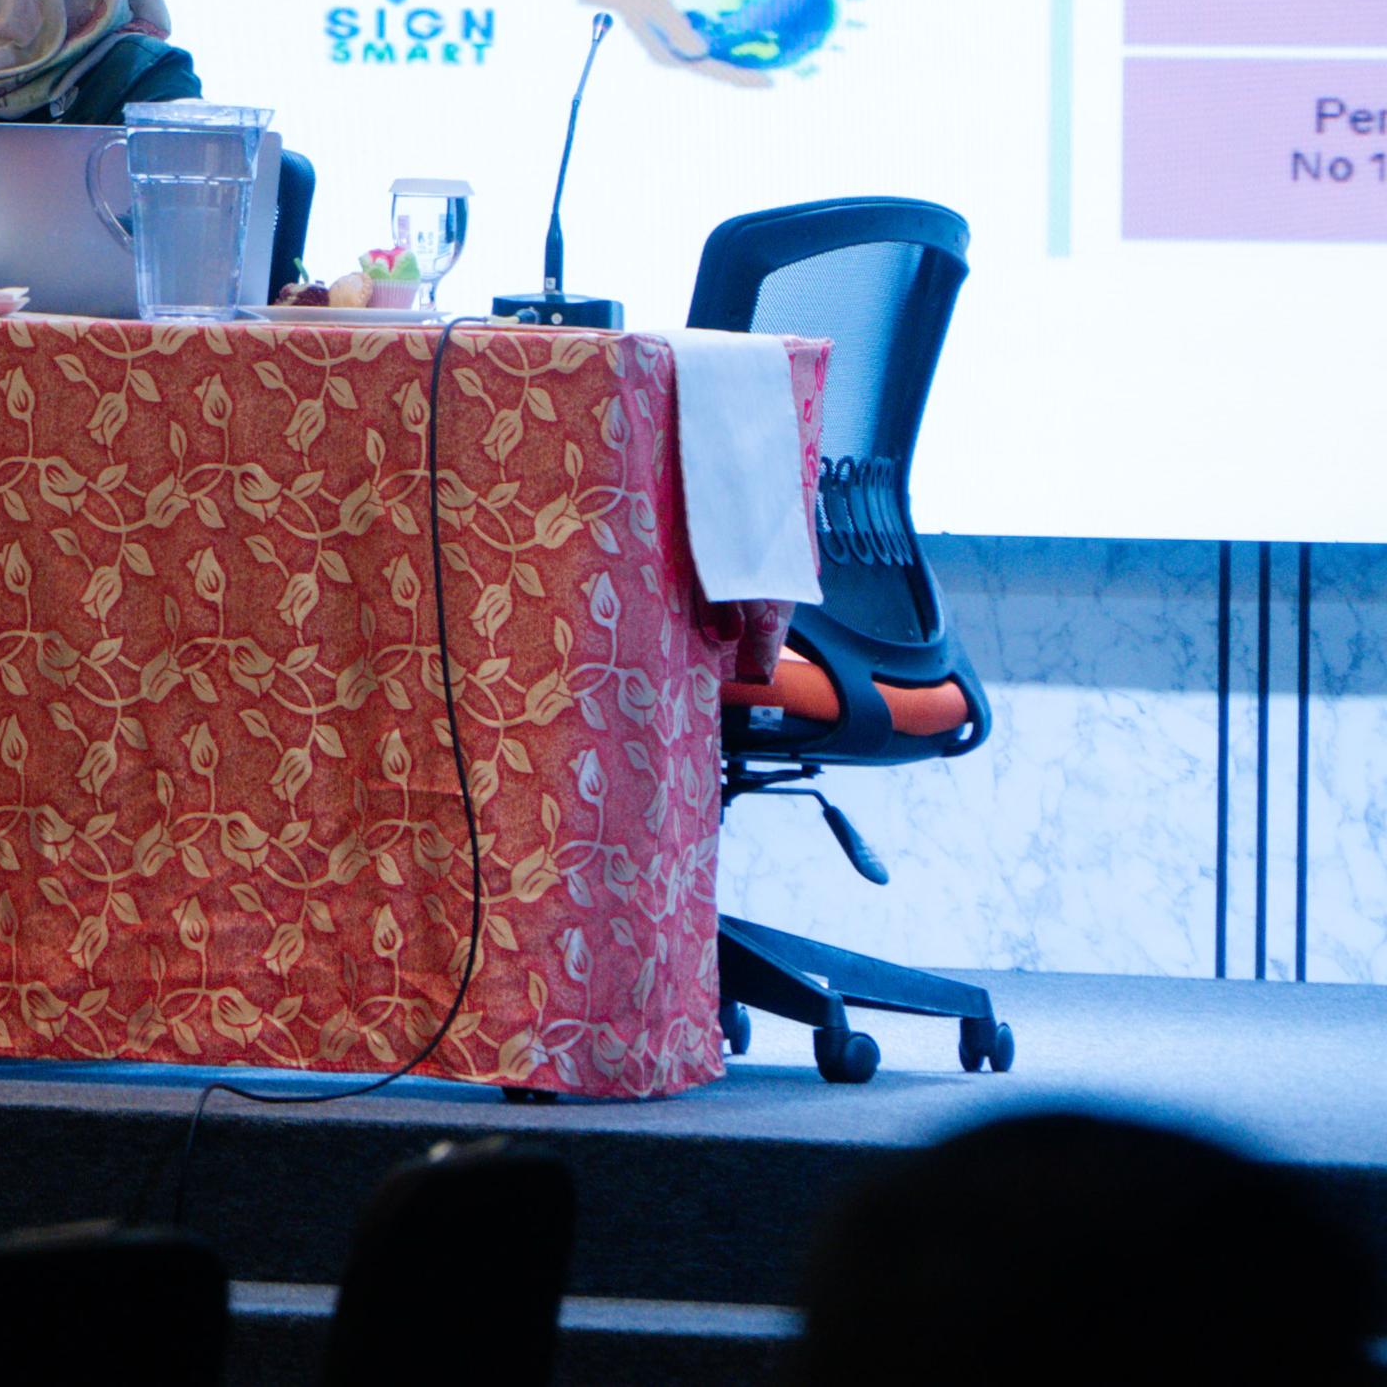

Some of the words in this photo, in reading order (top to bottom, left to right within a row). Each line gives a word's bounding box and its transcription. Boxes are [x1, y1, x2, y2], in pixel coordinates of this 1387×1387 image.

[324, 8, 495, 42] SIGN
[329, 42, 491, 65] SMART
[1290, 149, 1355, 184] No
